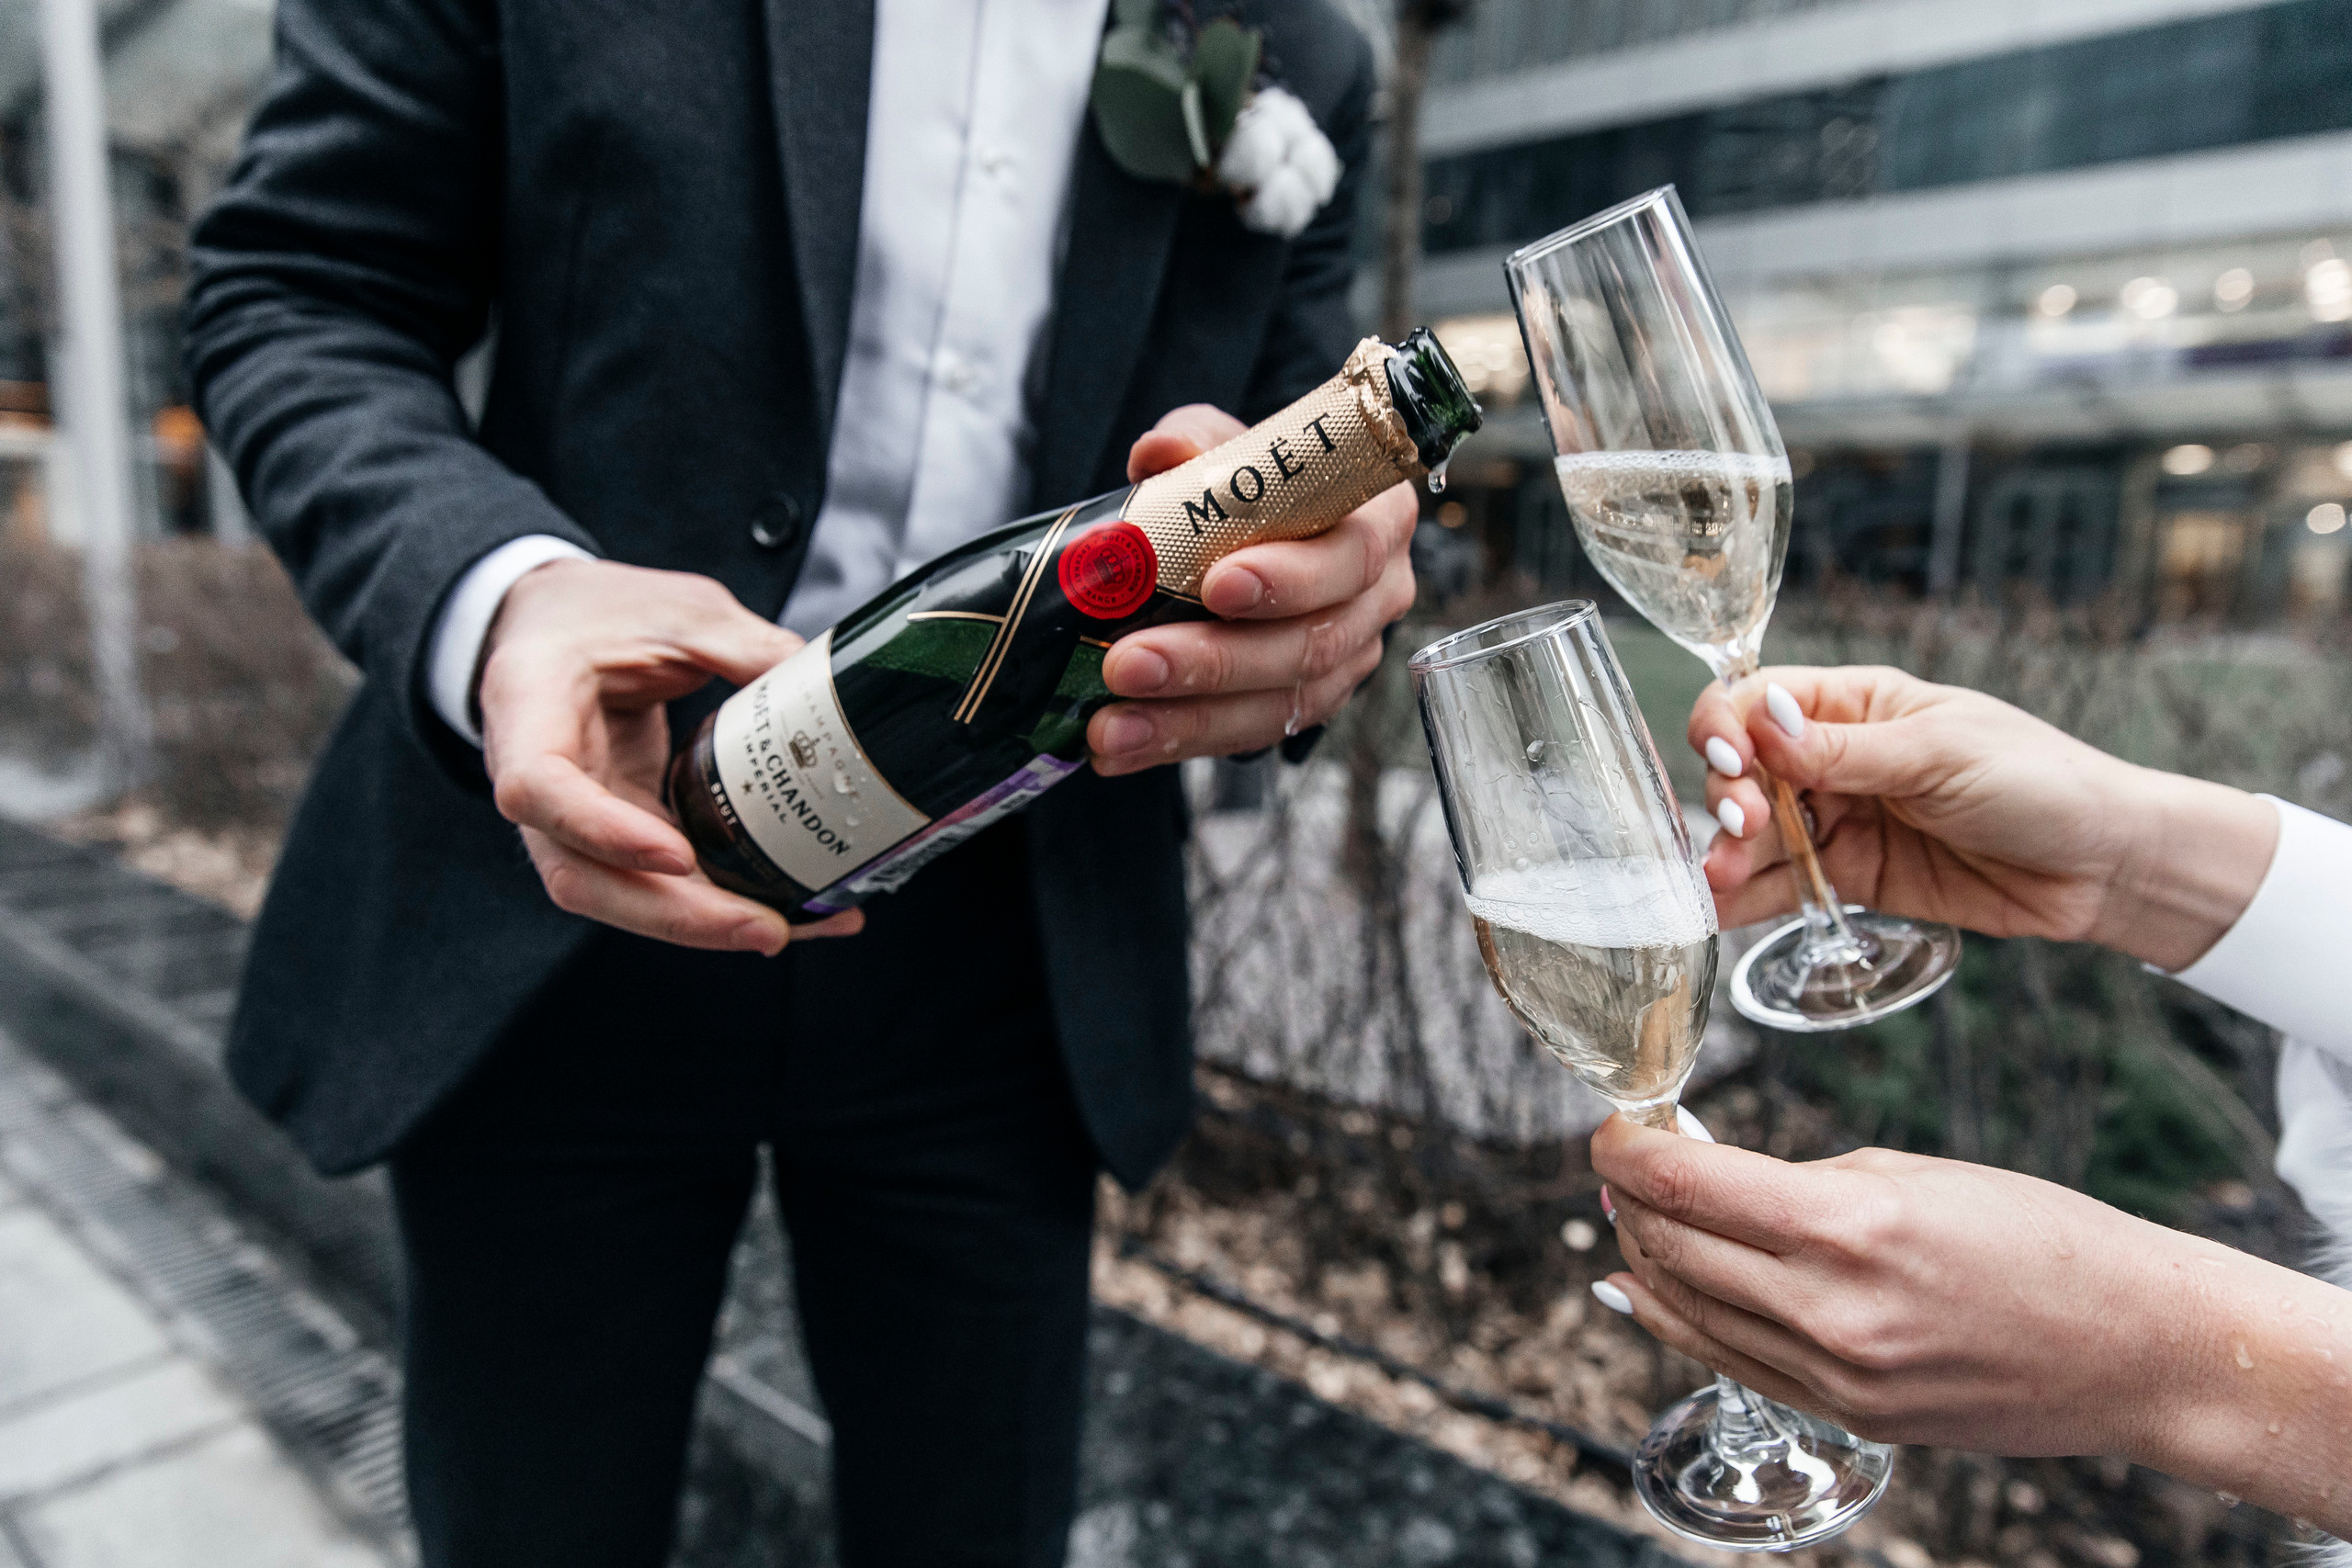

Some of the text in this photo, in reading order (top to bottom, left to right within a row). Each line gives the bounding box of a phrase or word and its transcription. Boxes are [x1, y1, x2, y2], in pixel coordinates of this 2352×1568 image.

[1182, 412, 1337, 535] MOËT
[743, 735, 788, 824] IMPERIAL
[759, 739, 773, 753] &
[710, 782, 738, 826] BRUT
[765, 753, 851, 855] CHANDON
